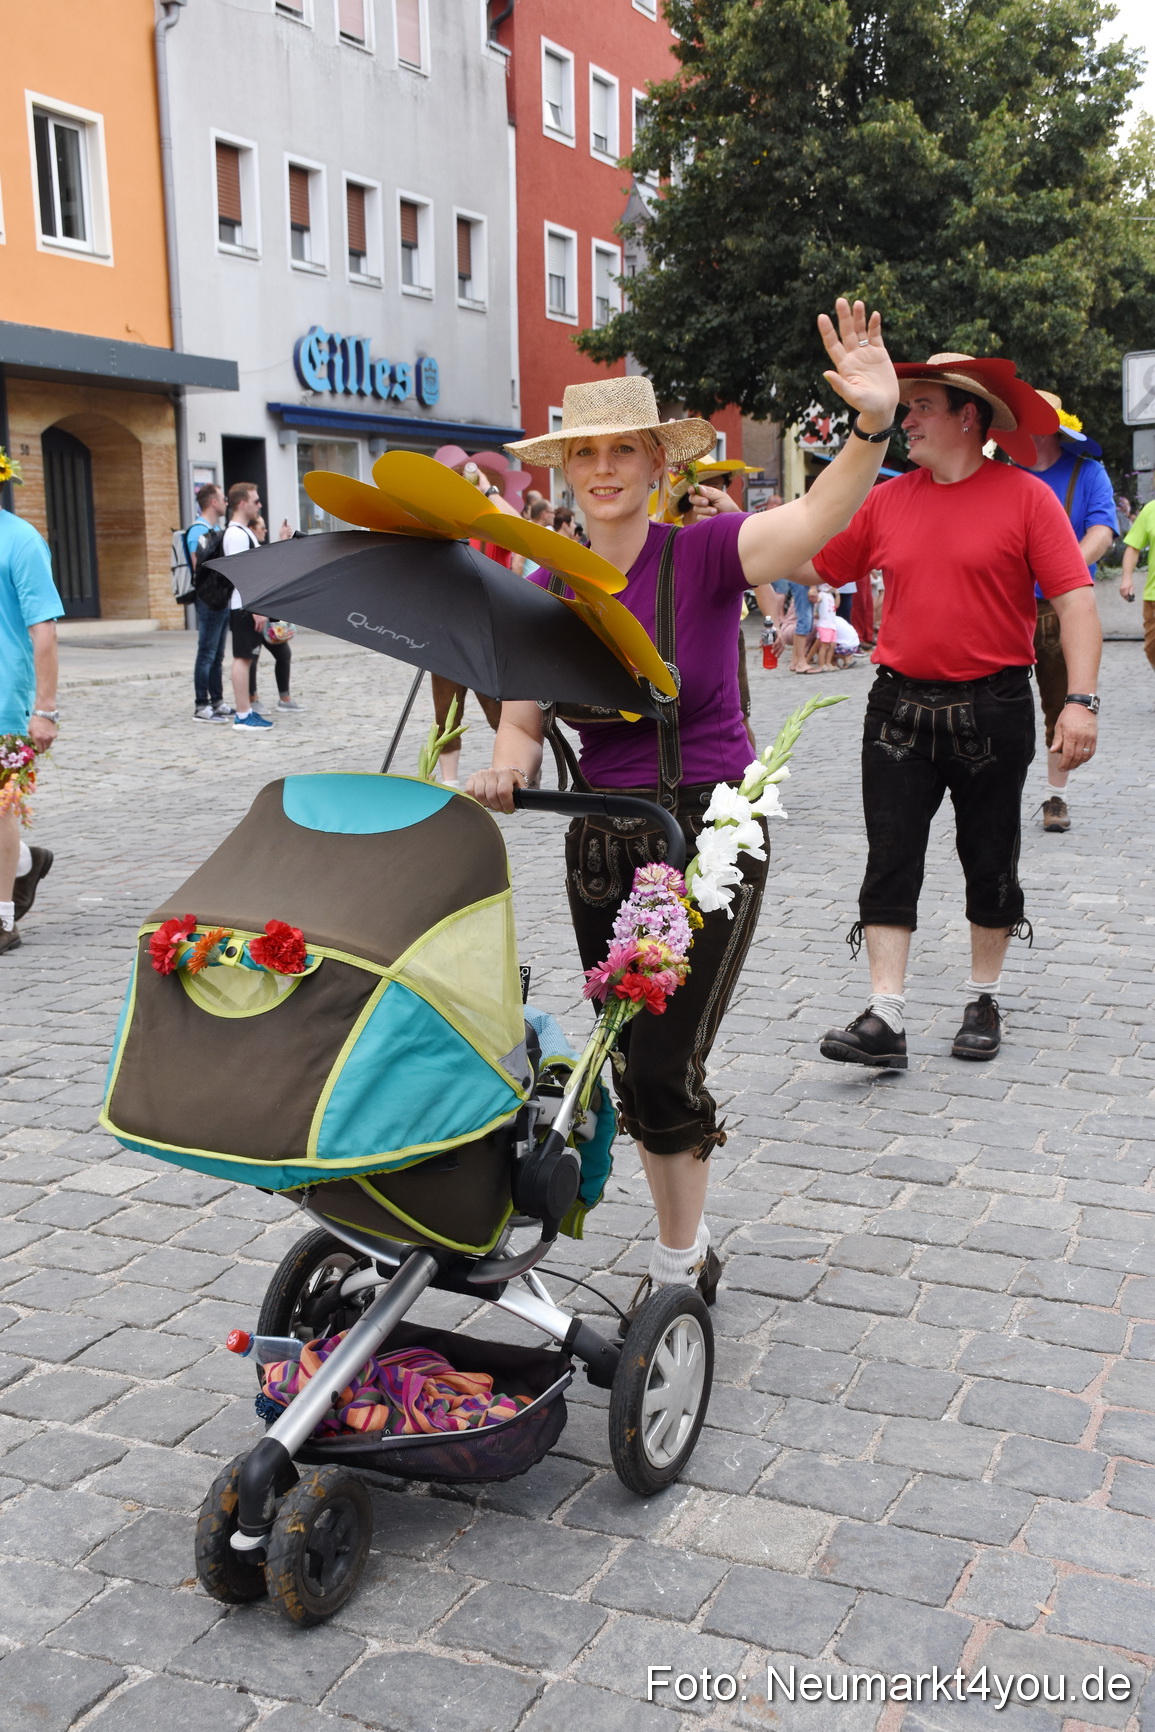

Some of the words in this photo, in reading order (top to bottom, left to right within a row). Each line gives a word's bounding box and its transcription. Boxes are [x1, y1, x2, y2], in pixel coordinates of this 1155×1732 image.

[298, 325, 412, 402] Eilles
[199, 432, 206, 443] 31
[347, 612, 426, 648] Quinny
